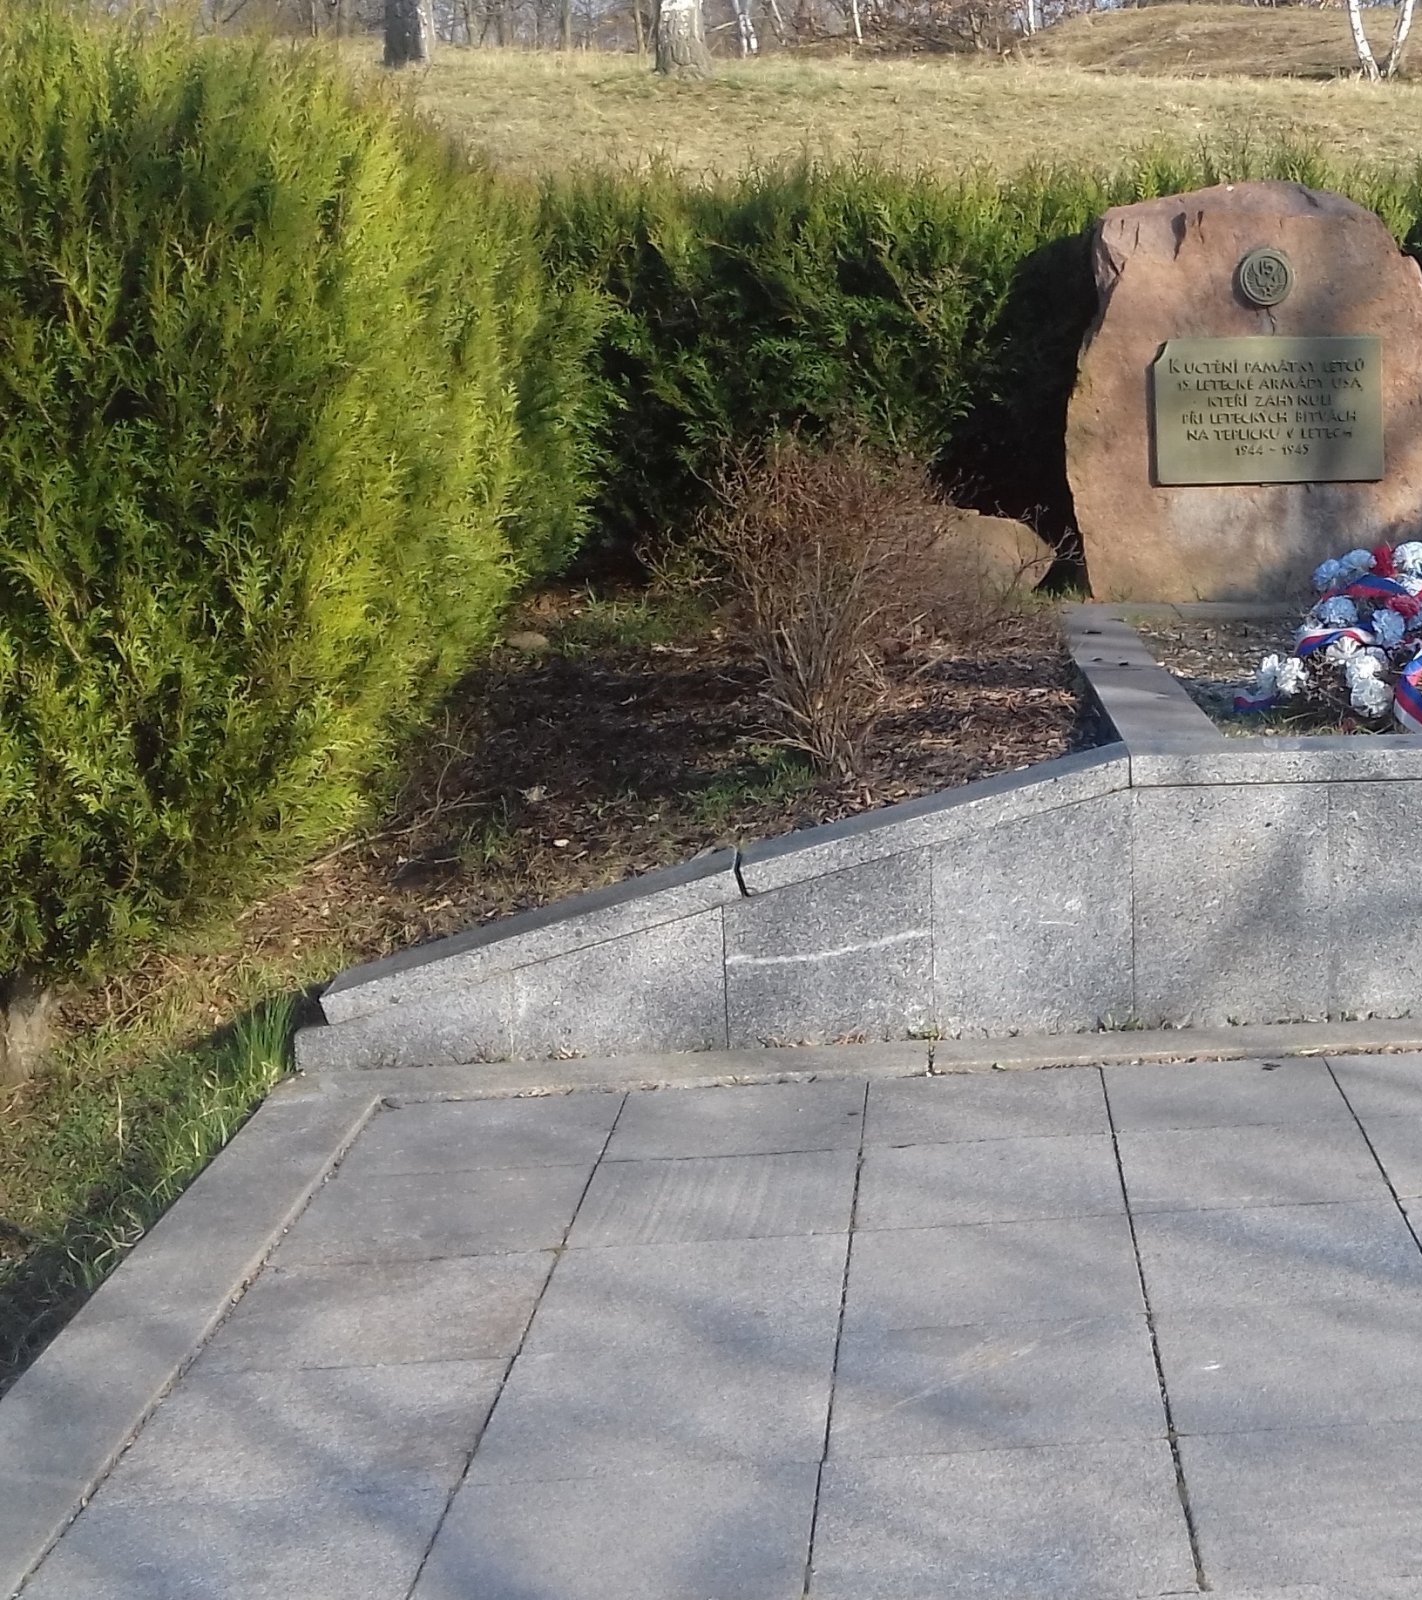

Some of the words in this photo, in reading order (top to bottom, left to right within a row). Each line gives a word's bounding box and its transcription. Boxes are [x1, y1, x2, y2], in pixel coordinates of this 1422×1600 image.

[1169, 359, 1180, 374] K
[1184, 359, 1238, 374] UCTĚNÍ
[1245, 359, 1313, 373] PAMÁTKY
[1323, 358, 1365, 373] LETCŮ
[1196, 379, 1252, 391] LETECKÉ
[1259, 379, 1323, 390] ARMÁDY
[1207, 394, 1247, 407] KTEŘÍ
[1182, 412, 1203, 424] PŘI
[1210, 411, 1287, 424] LETECKÝCH
[1295, 410, 1356, 423] BITVÁCH
[1187, 429, 1208, 441] NA
[1287, 429, 1295, 439] V
[1301, 428, 1353, 439] LETECH
[1235, 445, 1263, 456] 1944
[1282, 444, 1309, 455] 1945
